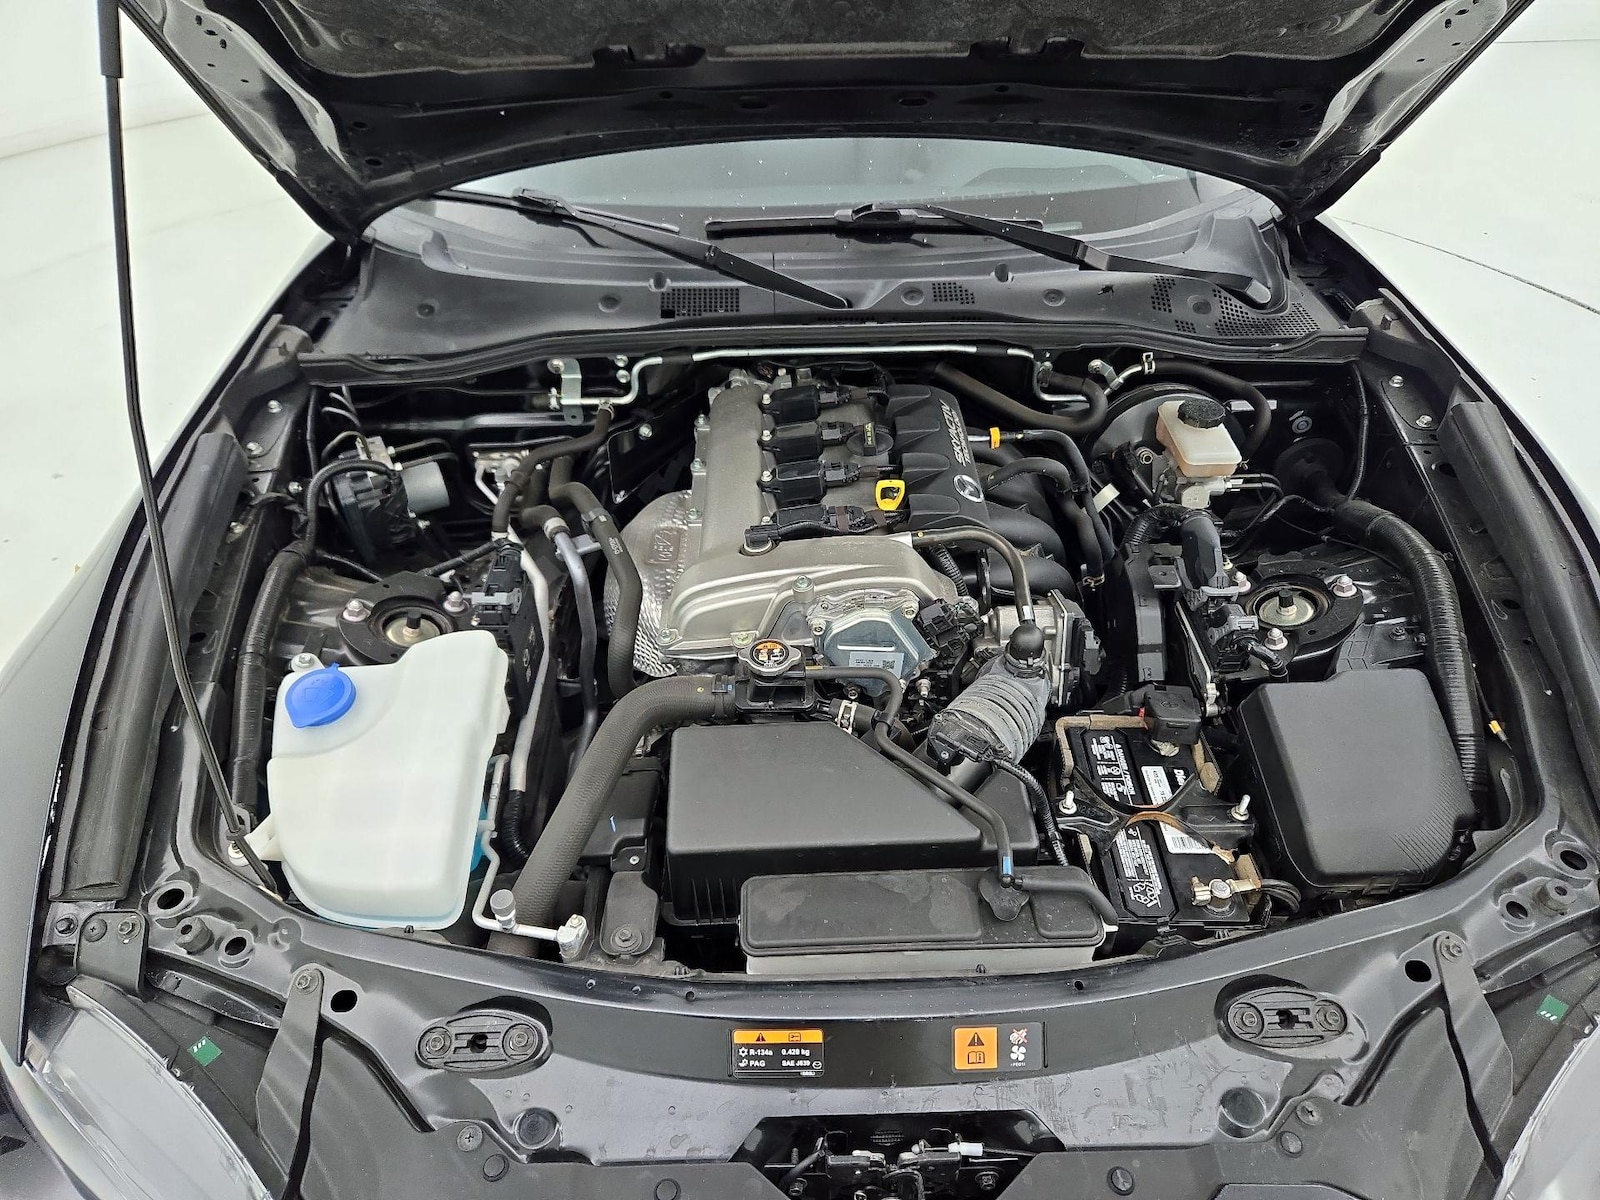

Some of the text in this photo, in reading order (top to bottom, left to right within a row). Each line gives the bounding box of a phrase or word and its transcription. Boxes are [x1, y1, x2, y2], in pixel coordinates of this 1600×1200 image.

[938, 398, 967, 468] SKYACTIV
[950, 407, 972, 465] TECHNOLOGY
[749, 1048, 773, 1056] R-134a
[801, 1048, 810, 1057] kg
